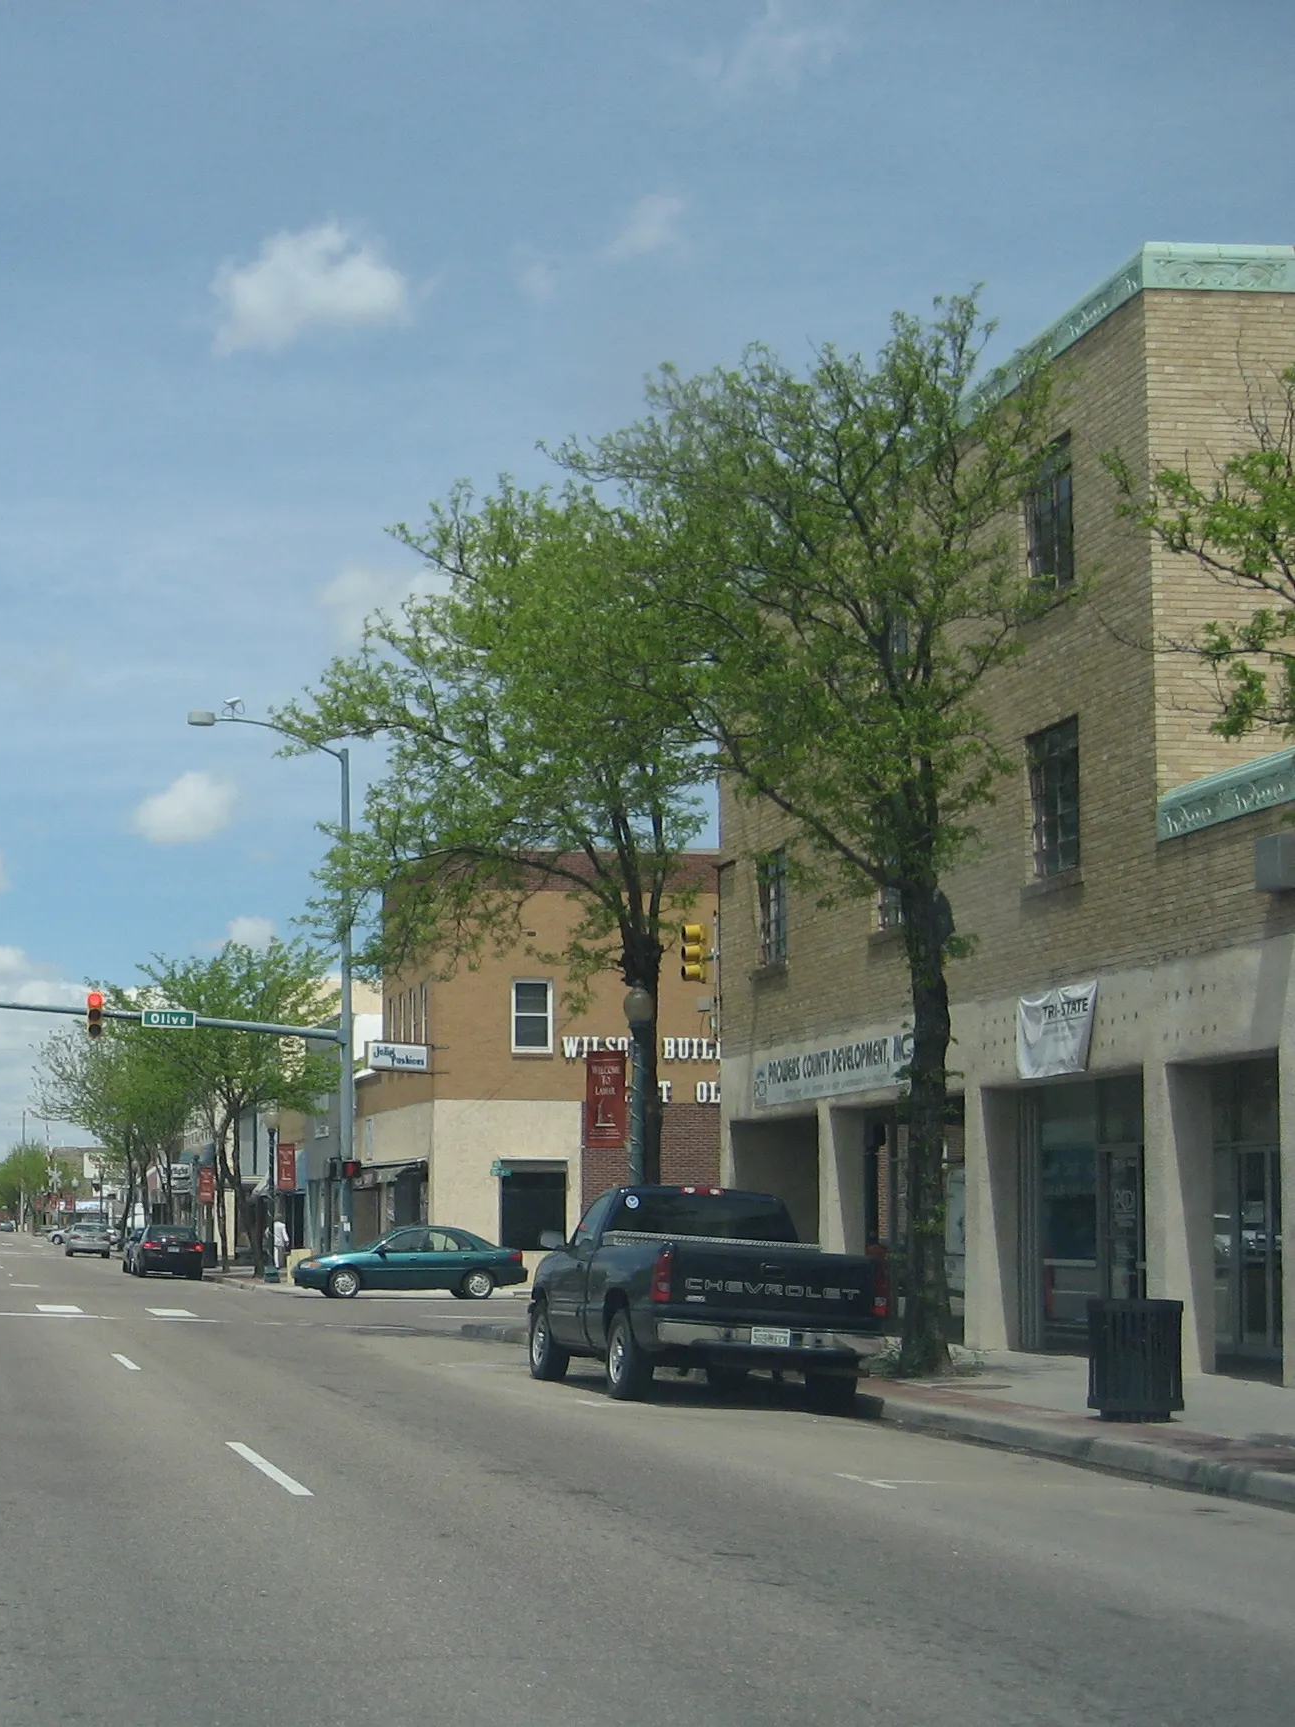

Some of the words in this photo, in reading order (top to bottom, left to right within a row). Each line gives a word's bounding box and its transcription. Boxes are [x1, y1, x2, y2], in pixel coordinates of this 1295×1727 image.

[150, 1013, 188, 1025] Olive
[1043, 997, 1089, 1020] TRI-STATE
[562, 1036, 635, 1059] WILSO
[802, 1048, 831, 1079] COUNTY
[684, 1277, 861, 1301] CHEVROLET
